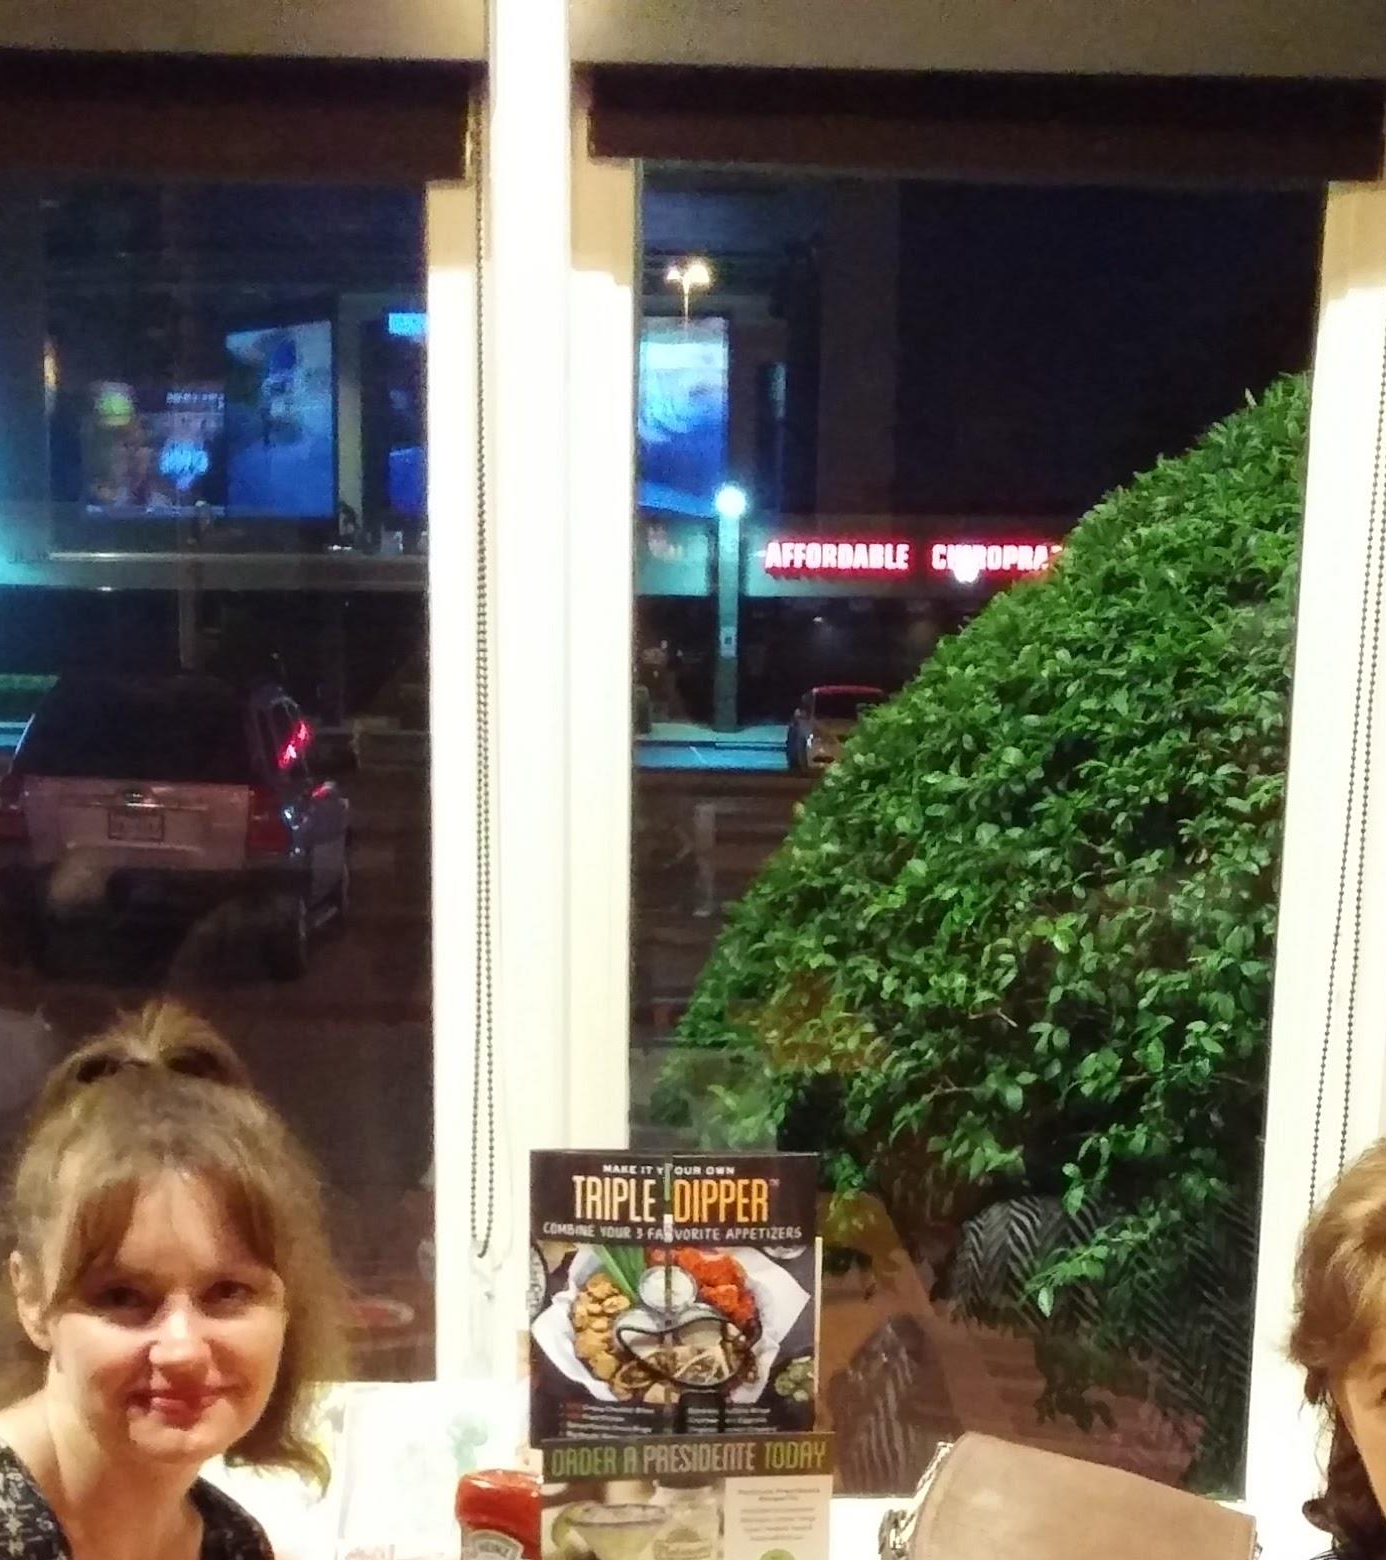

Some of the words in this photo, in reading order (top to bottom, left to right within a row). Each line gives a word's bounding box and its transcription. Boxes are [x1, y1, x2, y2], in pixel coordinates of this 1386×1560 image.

[765, 541, 910, 569] AFFORDABLE
[602, 1164, 638, 1175] MAKE
[640, 1166, 654, 1175] IT
[705, 1166, 736, 1176] OWN
[571, 1174, 657, 1223] TRIPLE
[673, 1178, 769, 1224] DIPPER
[542, 1222, 596, 1238] COMBINE
[599, 1225, 632, 1240] YOUR
[636, 1227, 644, 1240] 3
[647, 1227, 721, 1242] FAVORITE
[725, 1226, 803, 1241] APPETIZERS
[550, 1447, 617, 1478] ORDER
[623, 1446, 638, 1475] A
[642, 1443, 757, 1475] PRESIDENTE
[763, 1440, 828, 1472] TODAY
